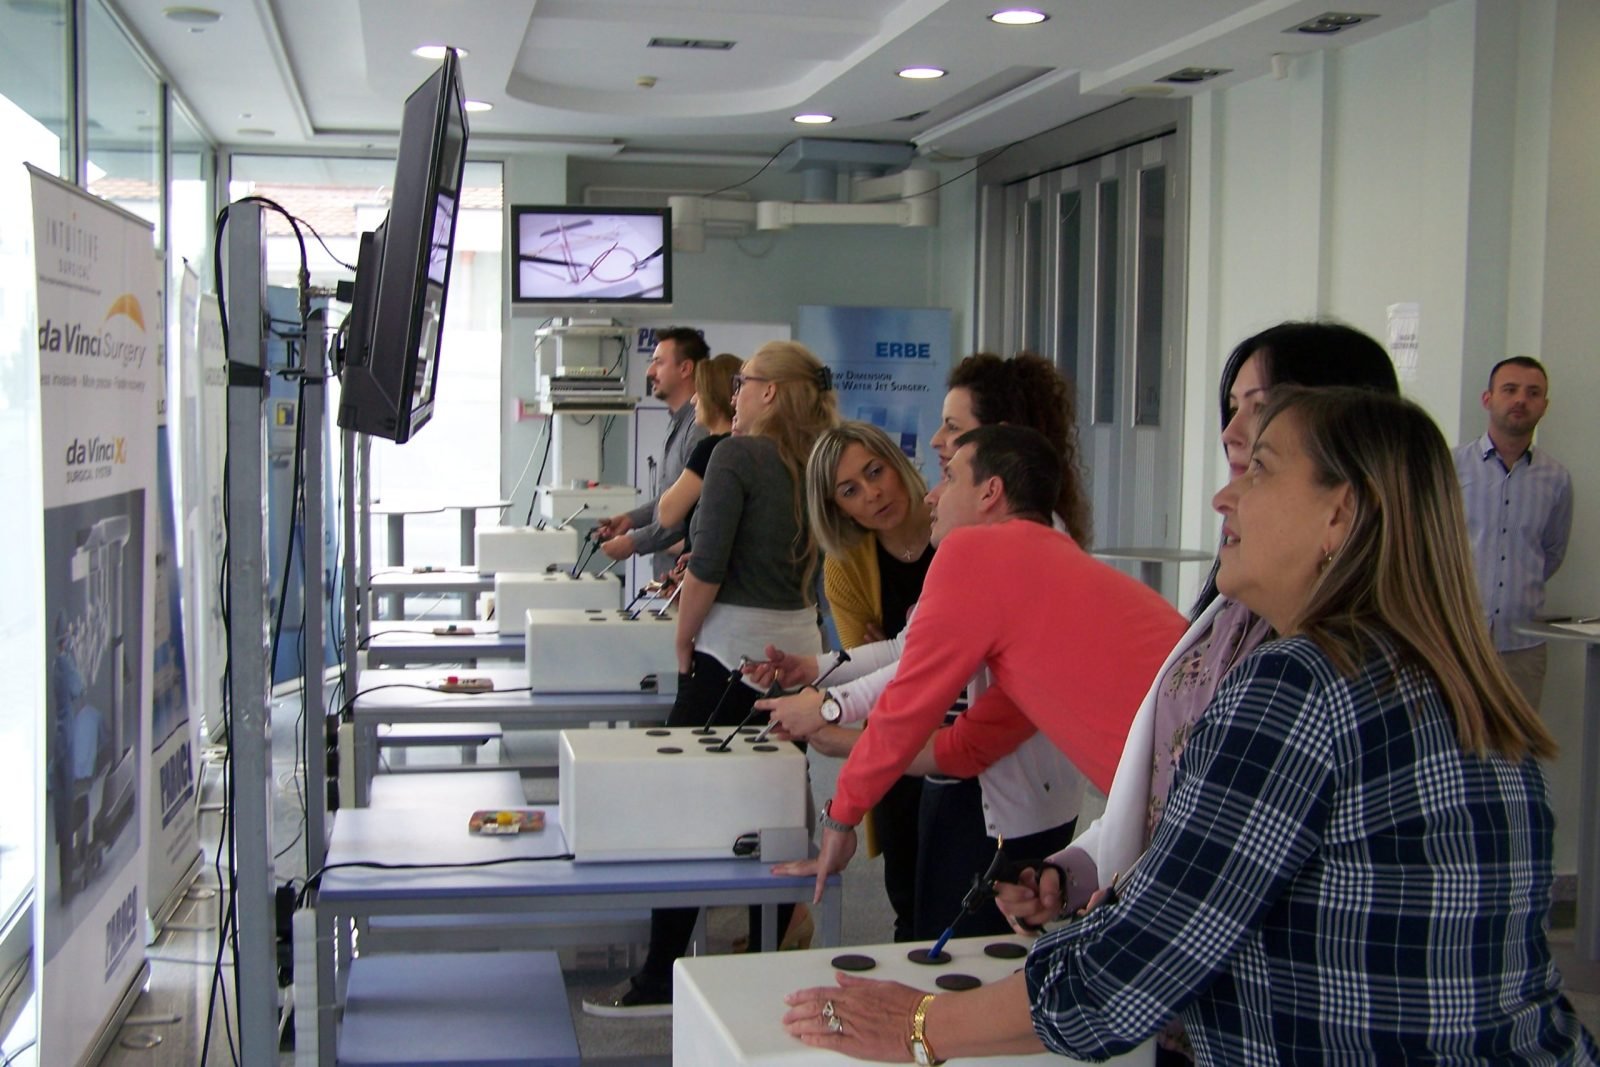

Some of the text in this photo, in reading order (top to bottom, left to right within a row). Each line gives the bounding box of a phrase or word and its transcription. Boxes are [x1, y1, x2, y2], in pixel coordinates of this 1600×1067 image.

[46, 212, 98, 262] INTUITIVE
[103, 332, 147, 369] Surgery
[875, 342, 931, 358] ERBE
